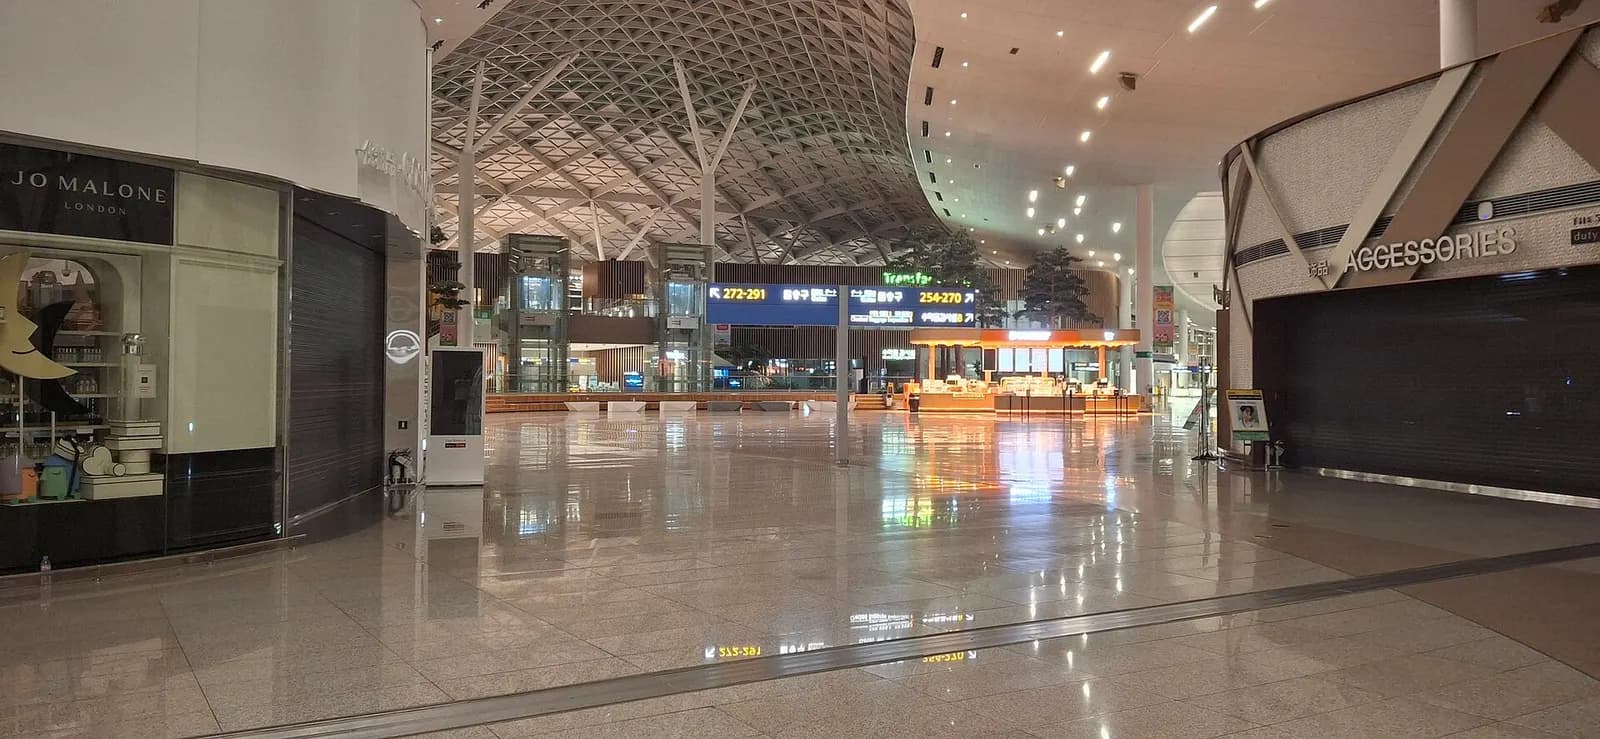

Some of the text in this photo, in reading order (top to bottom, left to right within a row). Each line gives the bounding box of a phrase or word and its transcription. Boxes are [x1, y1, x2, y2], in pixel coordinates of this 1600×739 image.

[12, 171, 168, 203] JO MALONE
[64, 202, 127, 215] LONDON
[1343, 227, 1518, 274] ACCESSORIES
[723, 287, 766, 300] 272-291
[919, 291, 962, 303] 254-270
